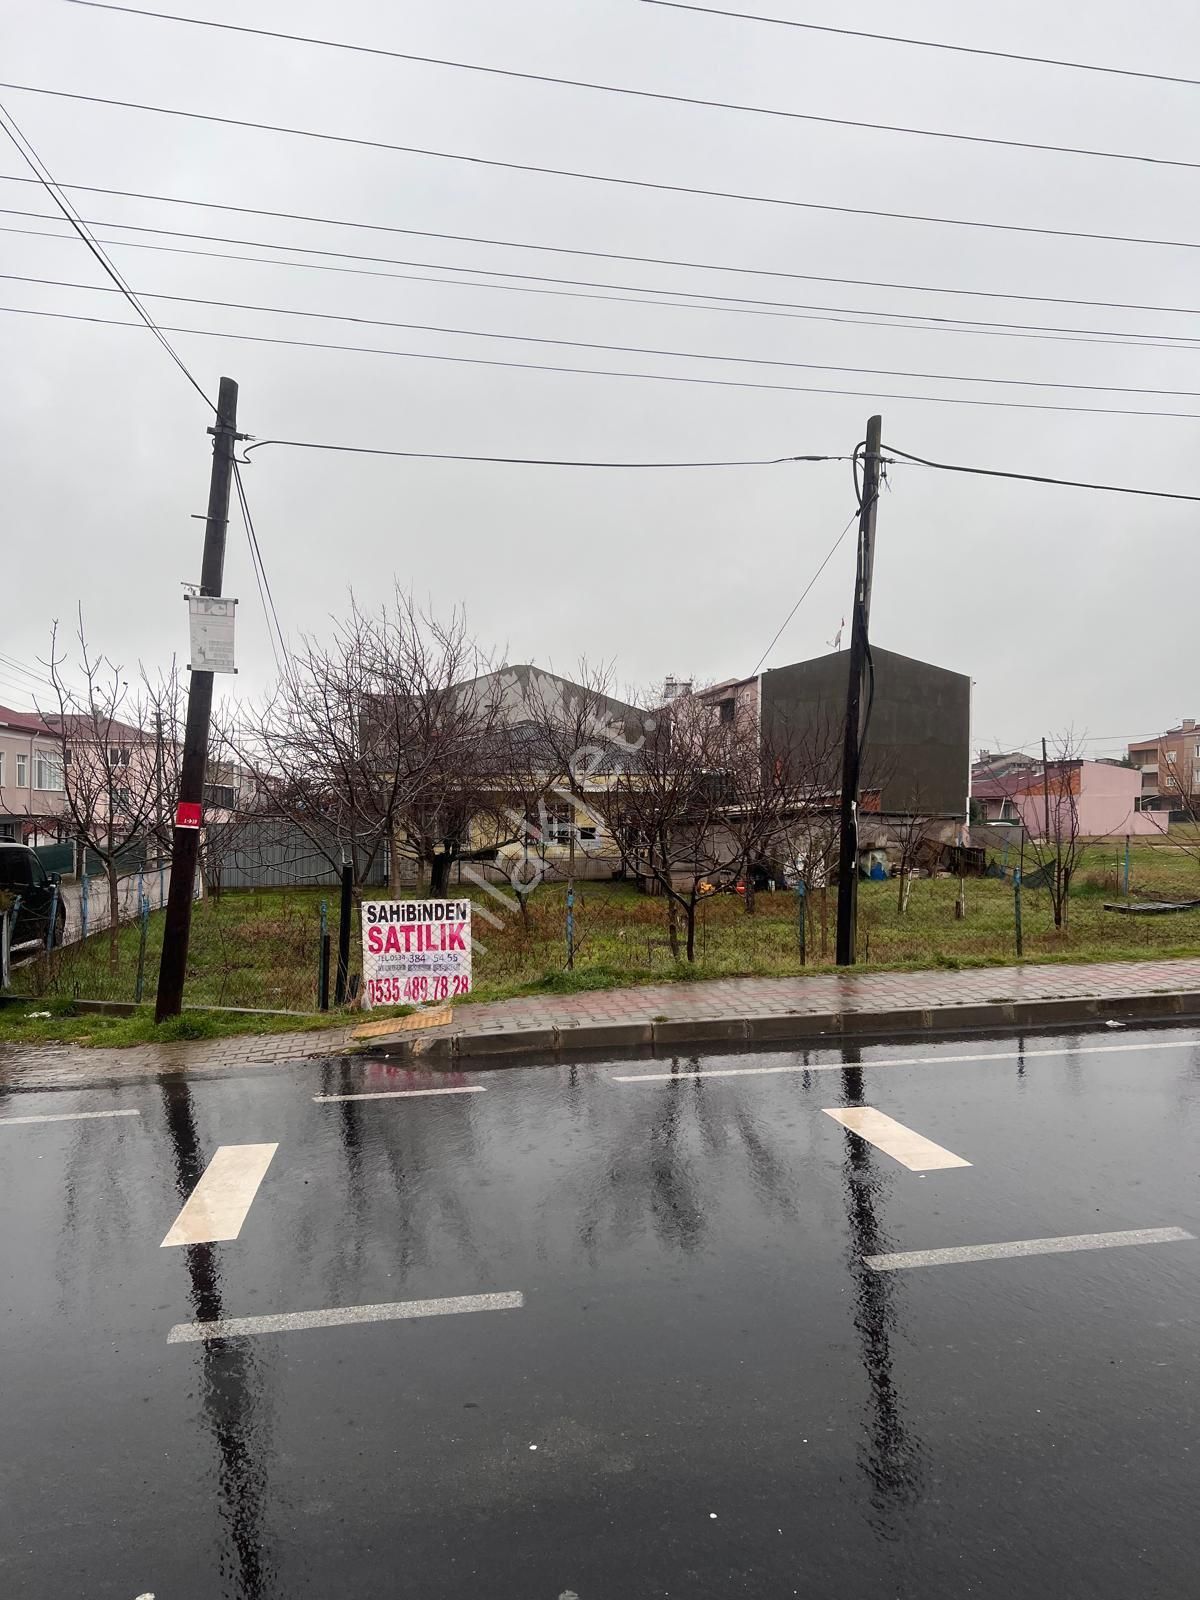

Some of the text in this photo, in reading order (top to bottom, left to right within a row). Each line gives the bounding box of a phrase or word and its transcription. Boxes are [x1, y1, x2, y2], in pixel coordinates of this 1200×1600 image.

[368, 923, 466, 954] SATILIK
[367, 974, 469, 1004] 0535 489 78 28
